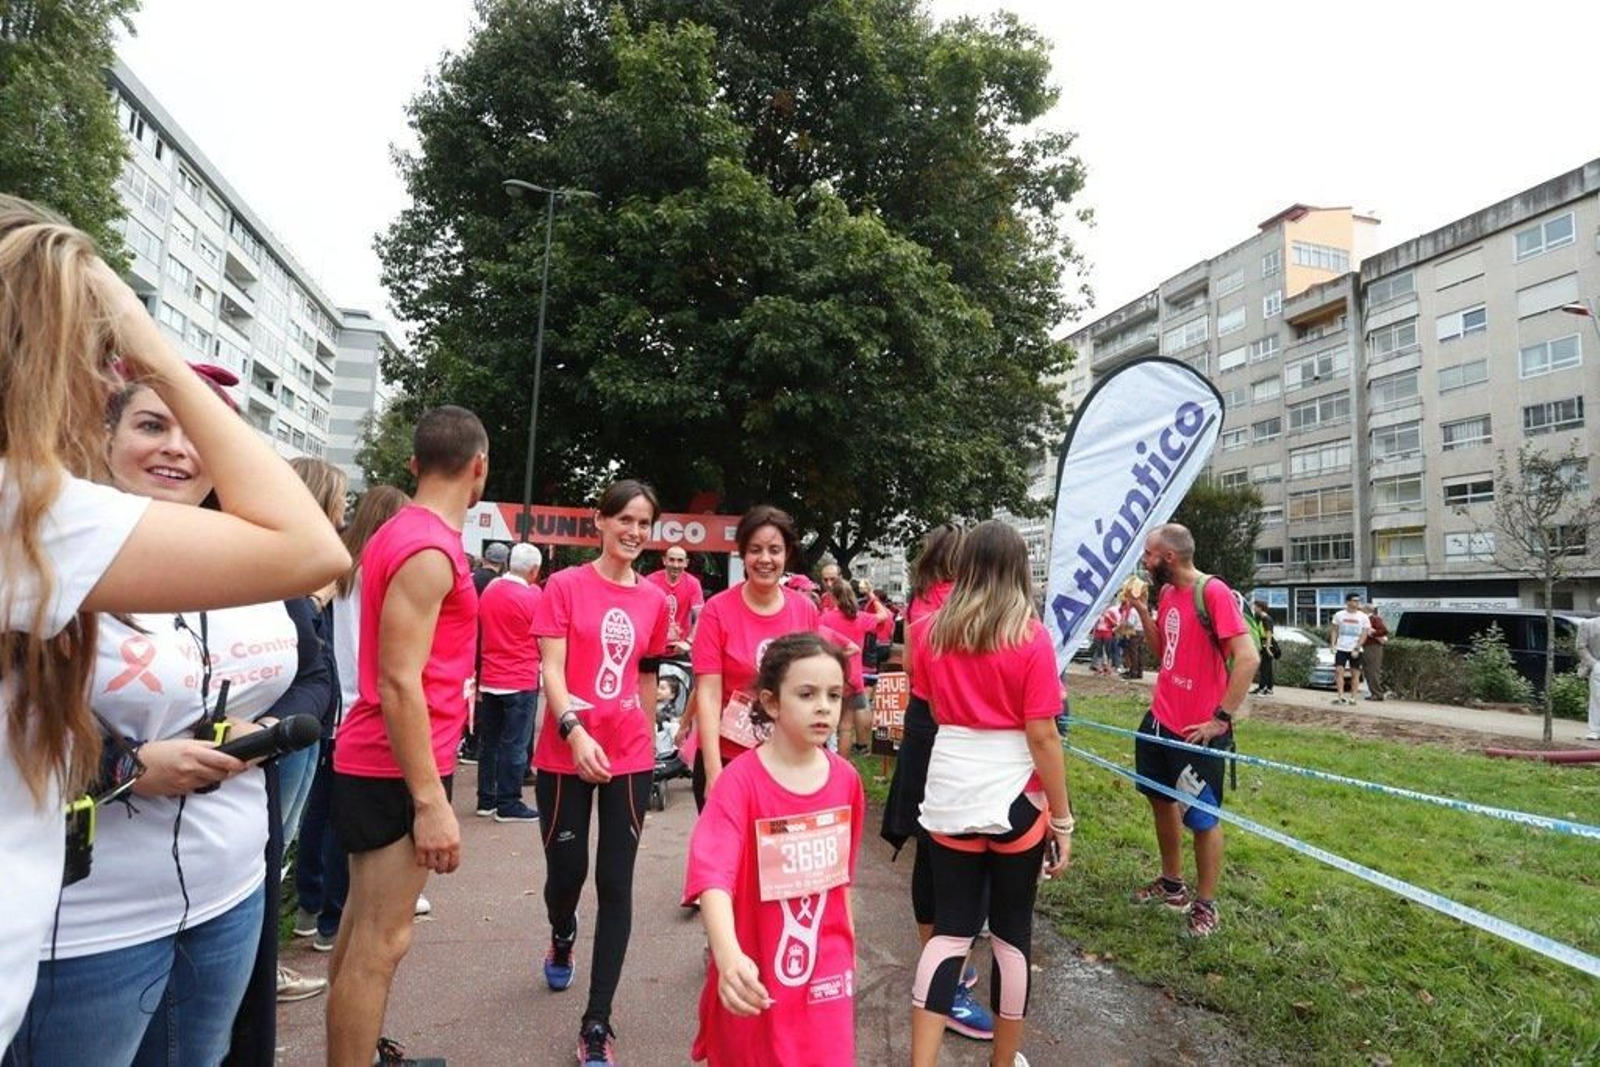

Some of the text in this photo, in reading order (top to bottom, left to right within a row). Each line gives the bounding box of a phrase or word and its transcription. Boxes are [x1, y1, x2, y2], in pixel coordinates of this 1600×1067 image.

[1051, 401, 1204, 646] Atlántico
[179, 645, 220, 665] Vio
[876, 677, 906, 693] SAVE
[875, 694, 900, 710] THE
[782, 836, 838, 875] 3698
